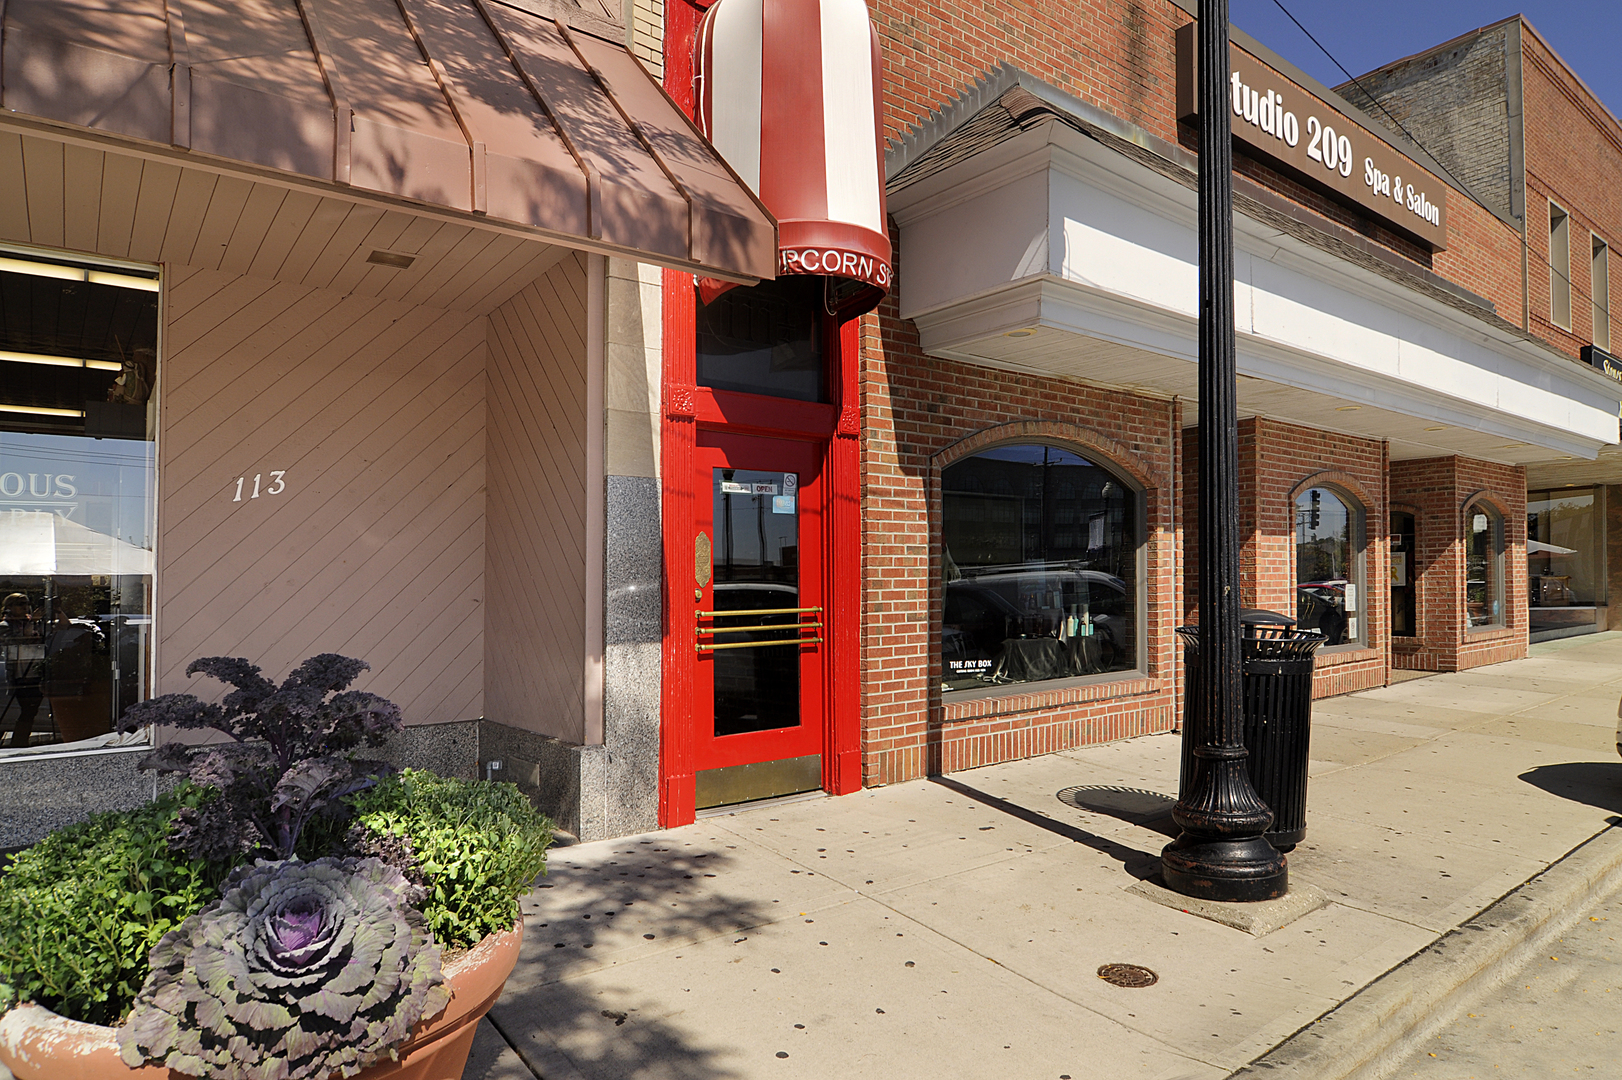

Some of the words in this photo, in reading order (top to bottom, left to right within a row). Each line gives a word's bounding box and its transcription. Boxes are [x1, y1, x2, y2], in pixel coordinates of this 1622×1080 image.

[1230, 71, 1299, 147] tudio
[1307, 116, 1353, 177] 209
[1364, 157, 1391, 196] Spa
[1393, 176, 1404, 205] &
[1406, 184, 1440, 226] Salon
[779, 249, 873, 279] PCORN
[232, 470, 286, 502] 113
[756, 485, 773, 493] OPEN
[950, 661, 963, 669] THE
[978, 660, 992, 668] BOX
